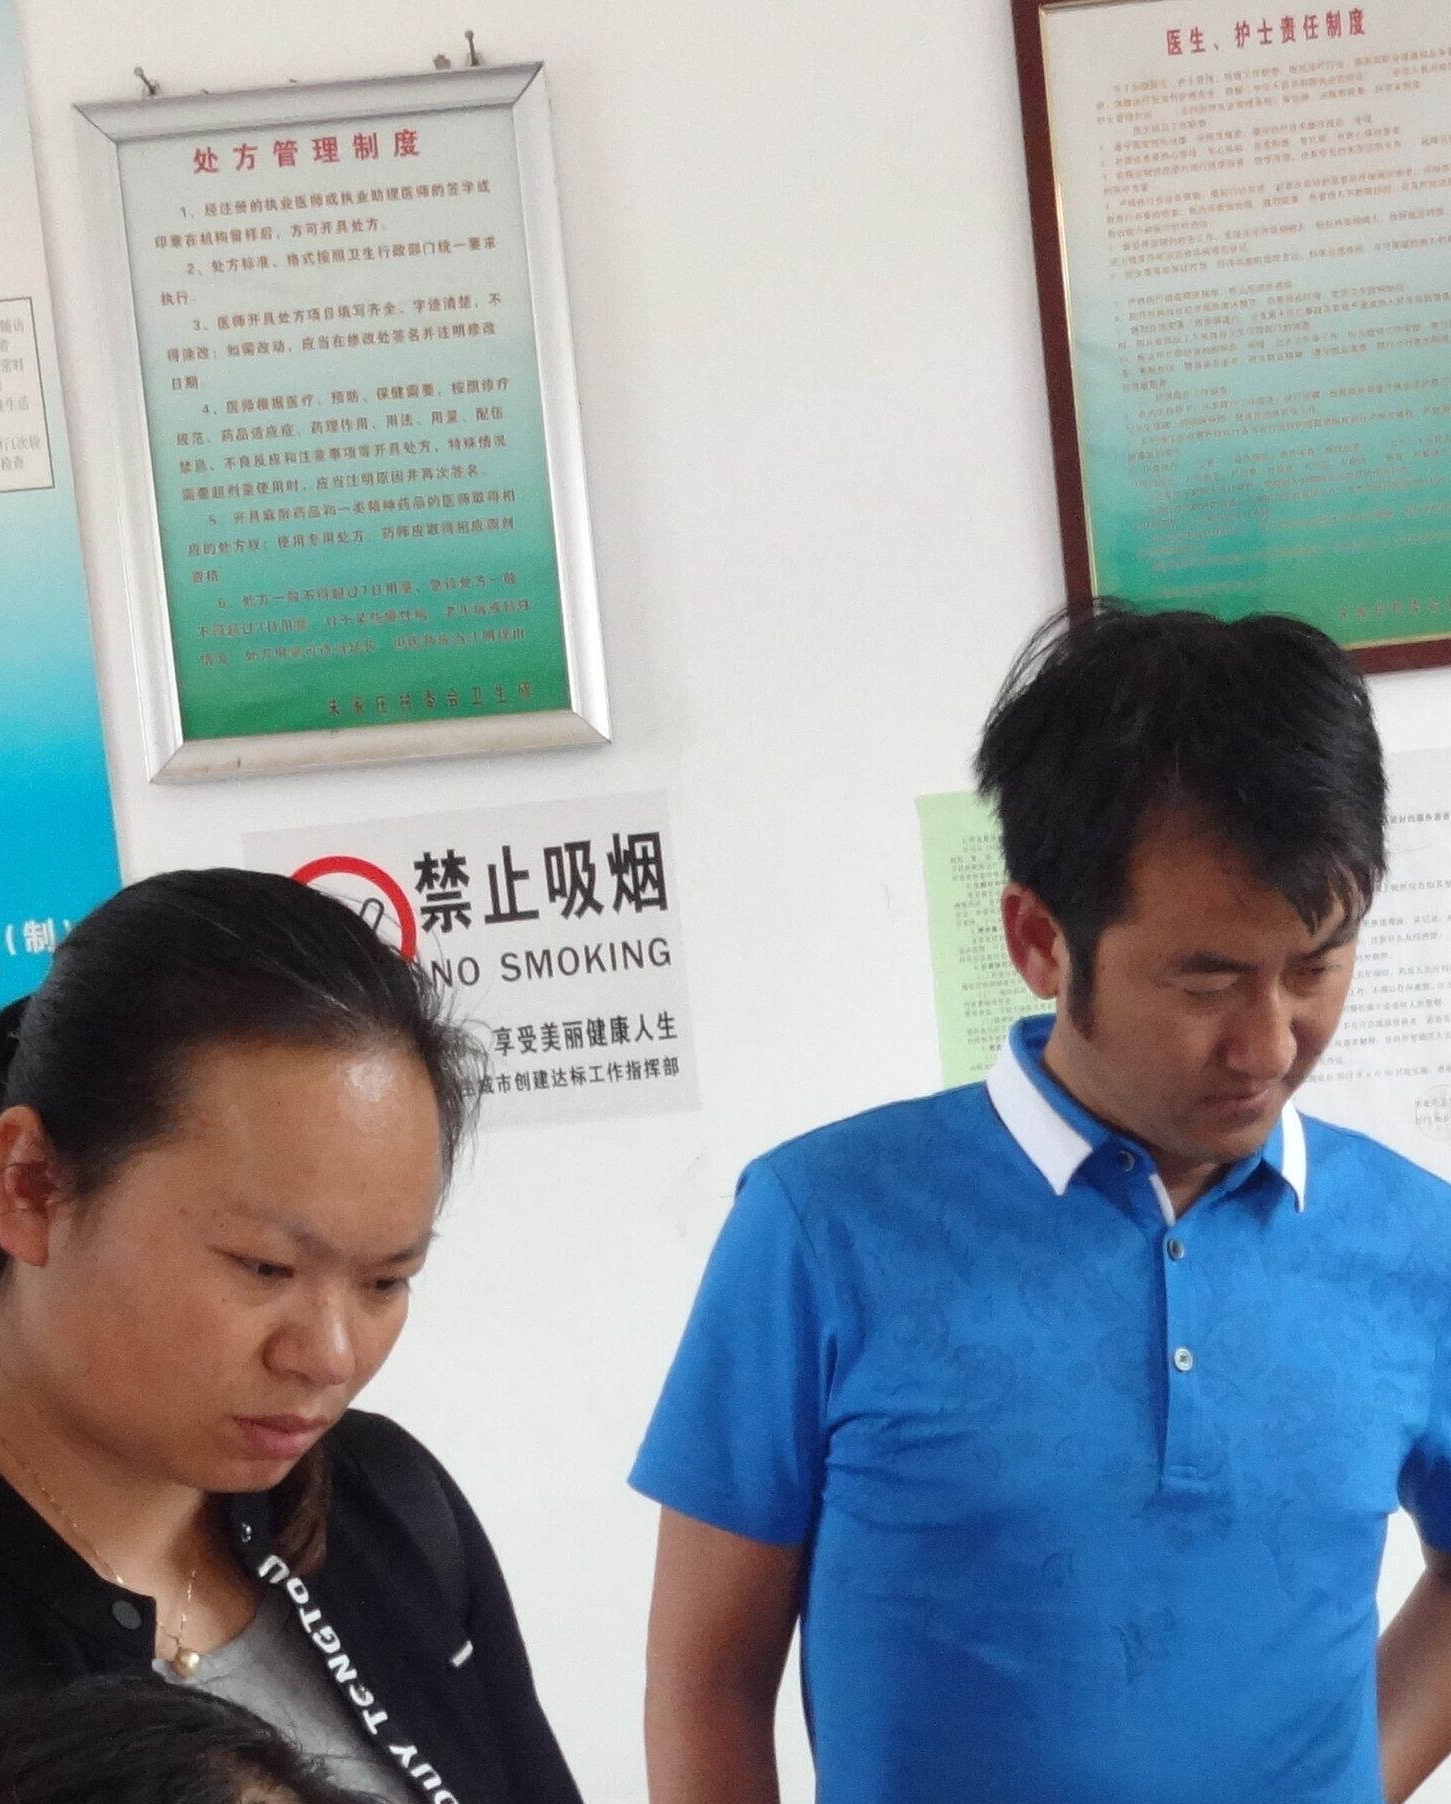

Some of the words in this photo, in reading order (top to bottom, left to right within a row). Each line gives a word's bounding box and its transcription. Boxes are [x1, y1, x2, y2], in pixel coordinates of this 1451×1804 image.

[1166, 8, 1367, 56] 医生、护士责任制度
[192, 129, 420, 174] 处方管理制度
[413, 831, 669, 934] 禁止吸烟
[430, 955, 481, 988] NO
[500, 937, 672, 983] SMOKING
[492, 1010, 678, 1056] 享受美丽健康人生
